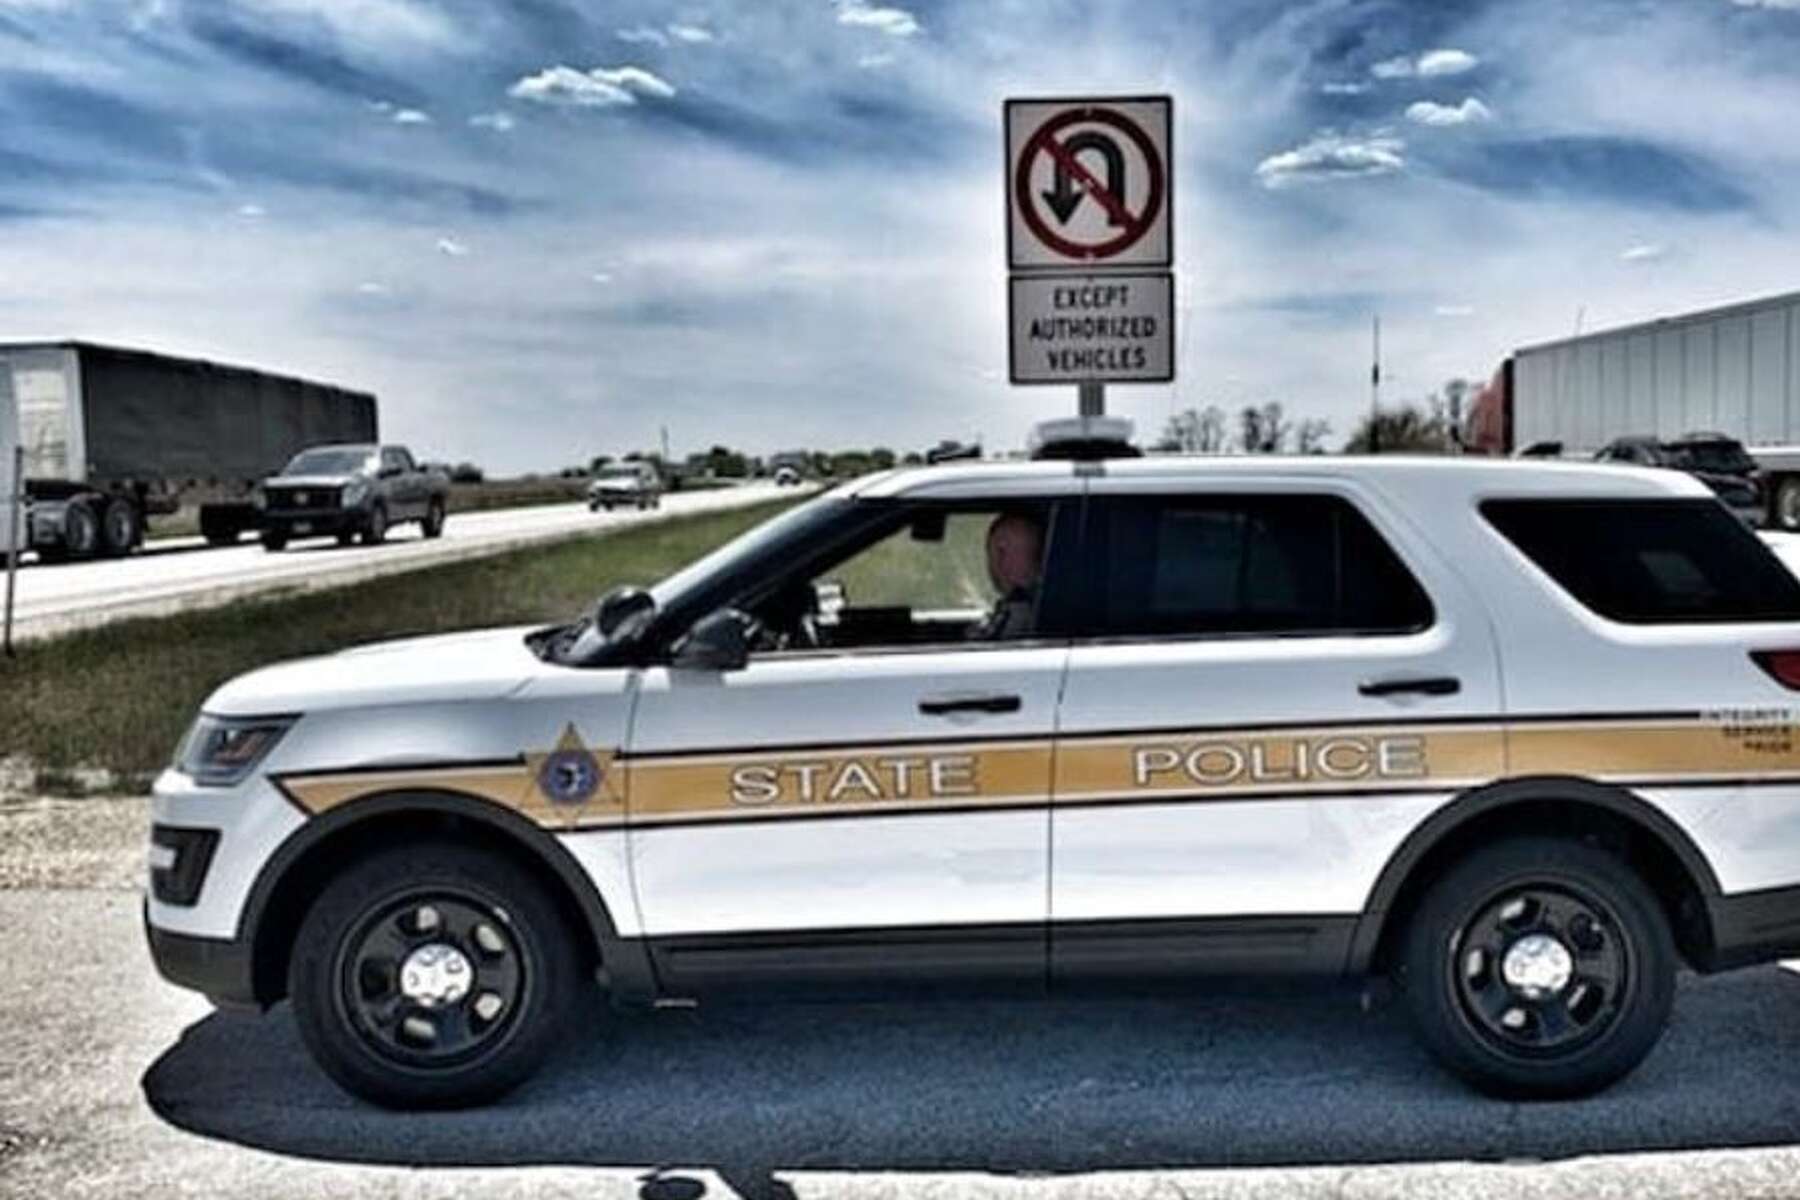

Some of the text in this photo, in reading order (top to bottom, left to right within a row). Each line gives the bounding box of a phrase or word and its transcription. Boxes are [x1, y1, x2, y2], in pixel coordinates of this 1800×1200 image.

[1053, 285, 1129, 309] EXCEPT
[1030, 317, 1157, 340] AUTHORIZED
[1048, 347, 1146, 371] VEHICLES
[730, 735, 1428, 803] STATE POLICE
